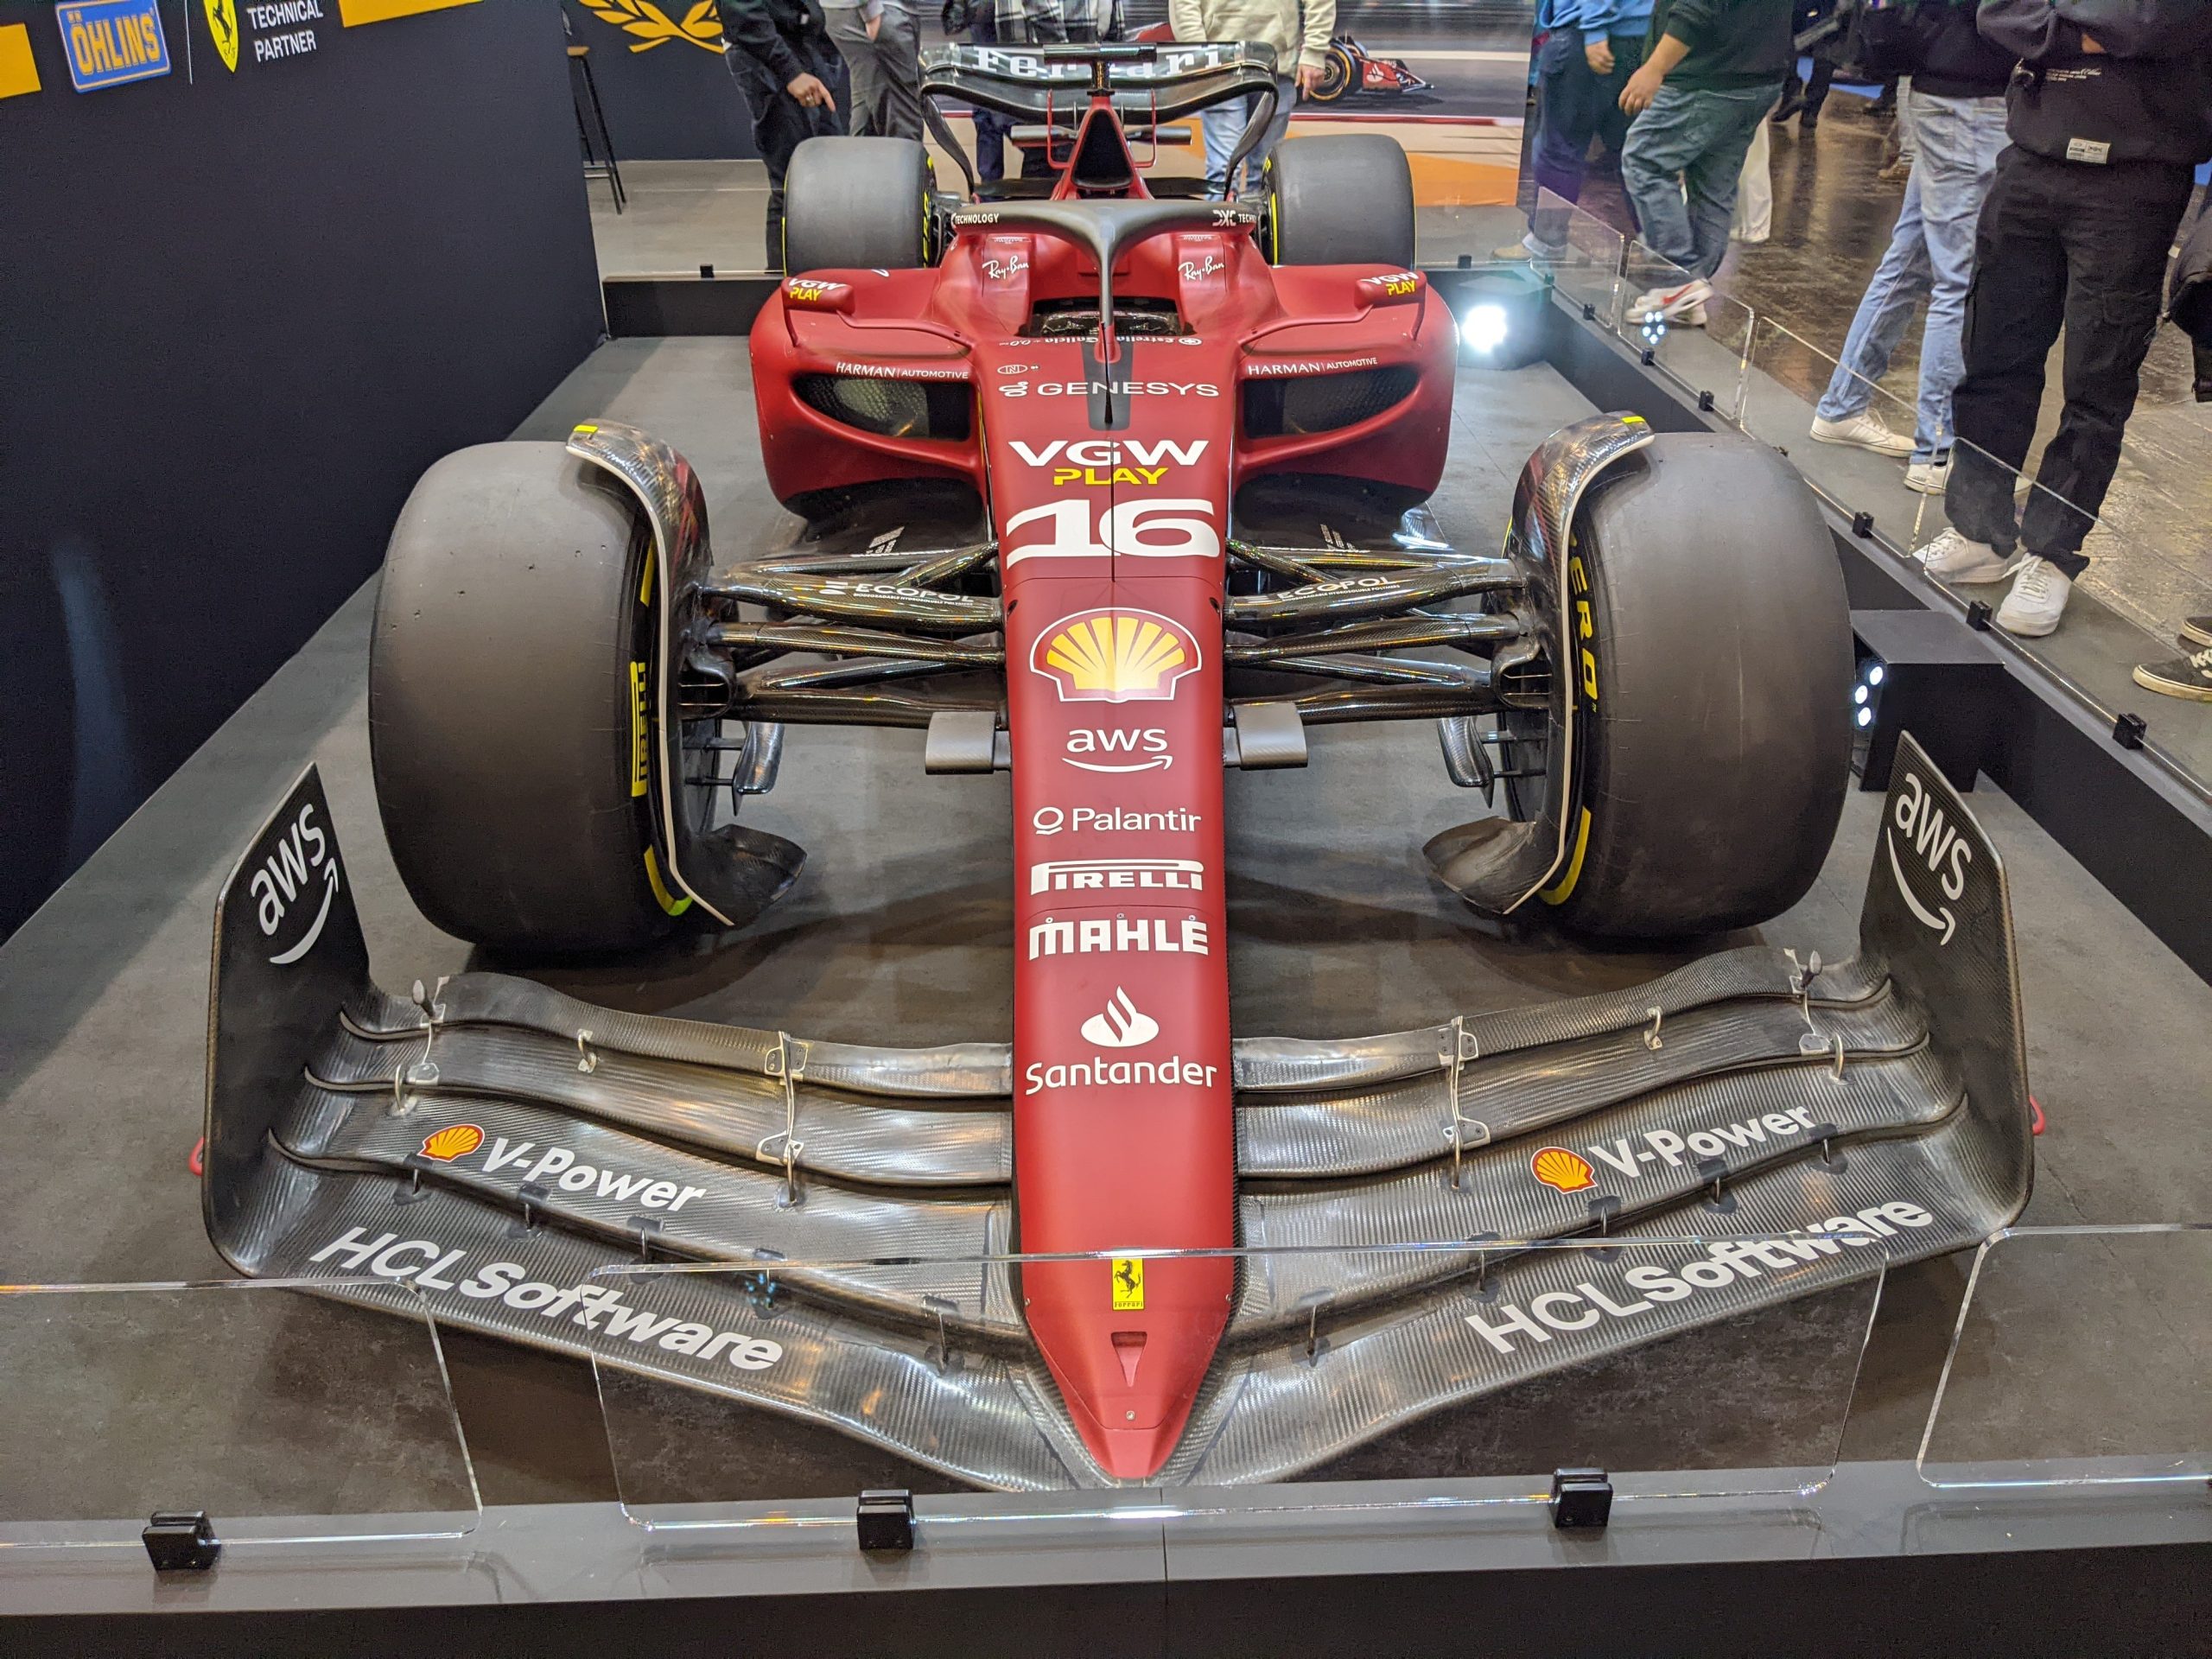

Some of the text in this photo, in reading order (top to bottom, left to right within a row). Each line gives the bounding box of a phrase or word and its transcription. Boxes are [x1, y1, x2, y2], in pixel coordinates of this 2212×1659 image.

[246, 1, 324, 30] TECHNICAL
[67, 11, 161, 75] ÖHLINS
[254, 30, 317, 62] PARTNER
[972, 44, 1223, 79] Ferari
[955, 213, 1000, 225] TECHNOLOGY
[1212, 209, 1236, 227] DXC
[788, 278, 848, 290] VGW
[1361, 271, 1420, 285] VGW
[1386, 280, 1417, 297] PLAY
[790, 286, 823, 302] PLAY
[836, 362, 969, 379] HARMAN AUTOMOTIVE
[1248, 357, 1378, 376] HARMAN AUTOMOTIVE
[1037, 382, 1219, 397] GENESYS
[1008, 440, 1209, 467] VGW
[1053, 467, 1169, 486] PLAY
[1006, 499, 1220, 570] 16
[855, 582, 975, 602] ECOPOL
[1278, 576, 1389, 600] ECOPOL
[1569, 532, 1598, 700] ERO
[1066, 728, 1168, 753] aws
[1072, 807, 1201, 831] Palantir
[1895, 772, 1971, 900] aws
[251, 804, 326, 936] aws
[1031, 859, 1204, 895] PIRELLI
[1029, 919, 1209, 961] MAHLE
[1026, 1055, 1217, 1096] Santander
[1588, 1106, 1818, 1179] V-Power
[481, 1137, 708, 1211] V-Power
[309, 1226, 784, 1370] HCLSoftware
